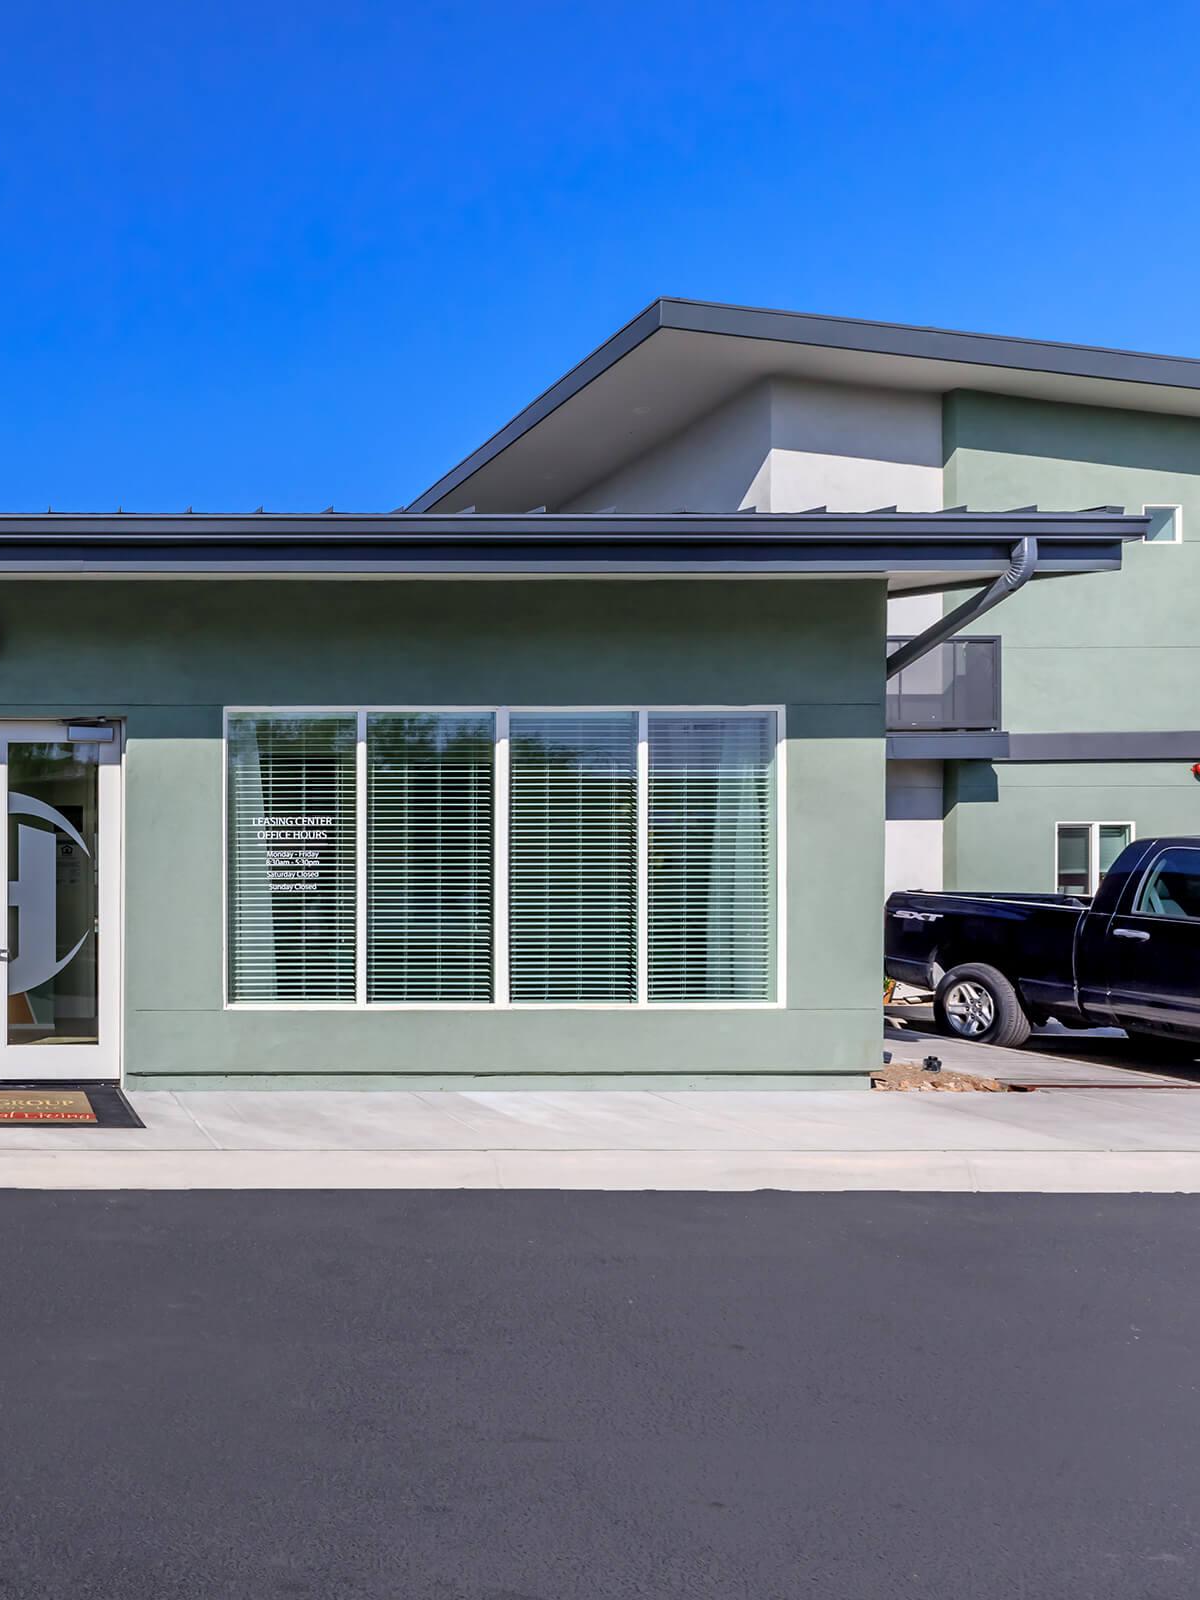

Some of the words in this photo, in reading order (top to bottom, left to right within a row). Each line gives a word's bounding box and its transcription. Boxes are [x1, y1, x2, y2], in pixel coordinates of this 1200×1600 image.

[252, 816, 294, 825] LEASING
[295, 816, 333, 825] CENTER
[257, 830, 292, 839] OFFICE
[293, 830, 328, 839] HOURS
[266, 850, 293, 859] Monday
[299, 850, 320, 859] Friday
[266, 871, 296, 879] Saturday
[268, 884, 293, 892] Sunday
[892, 910, 944, 922] SXT
